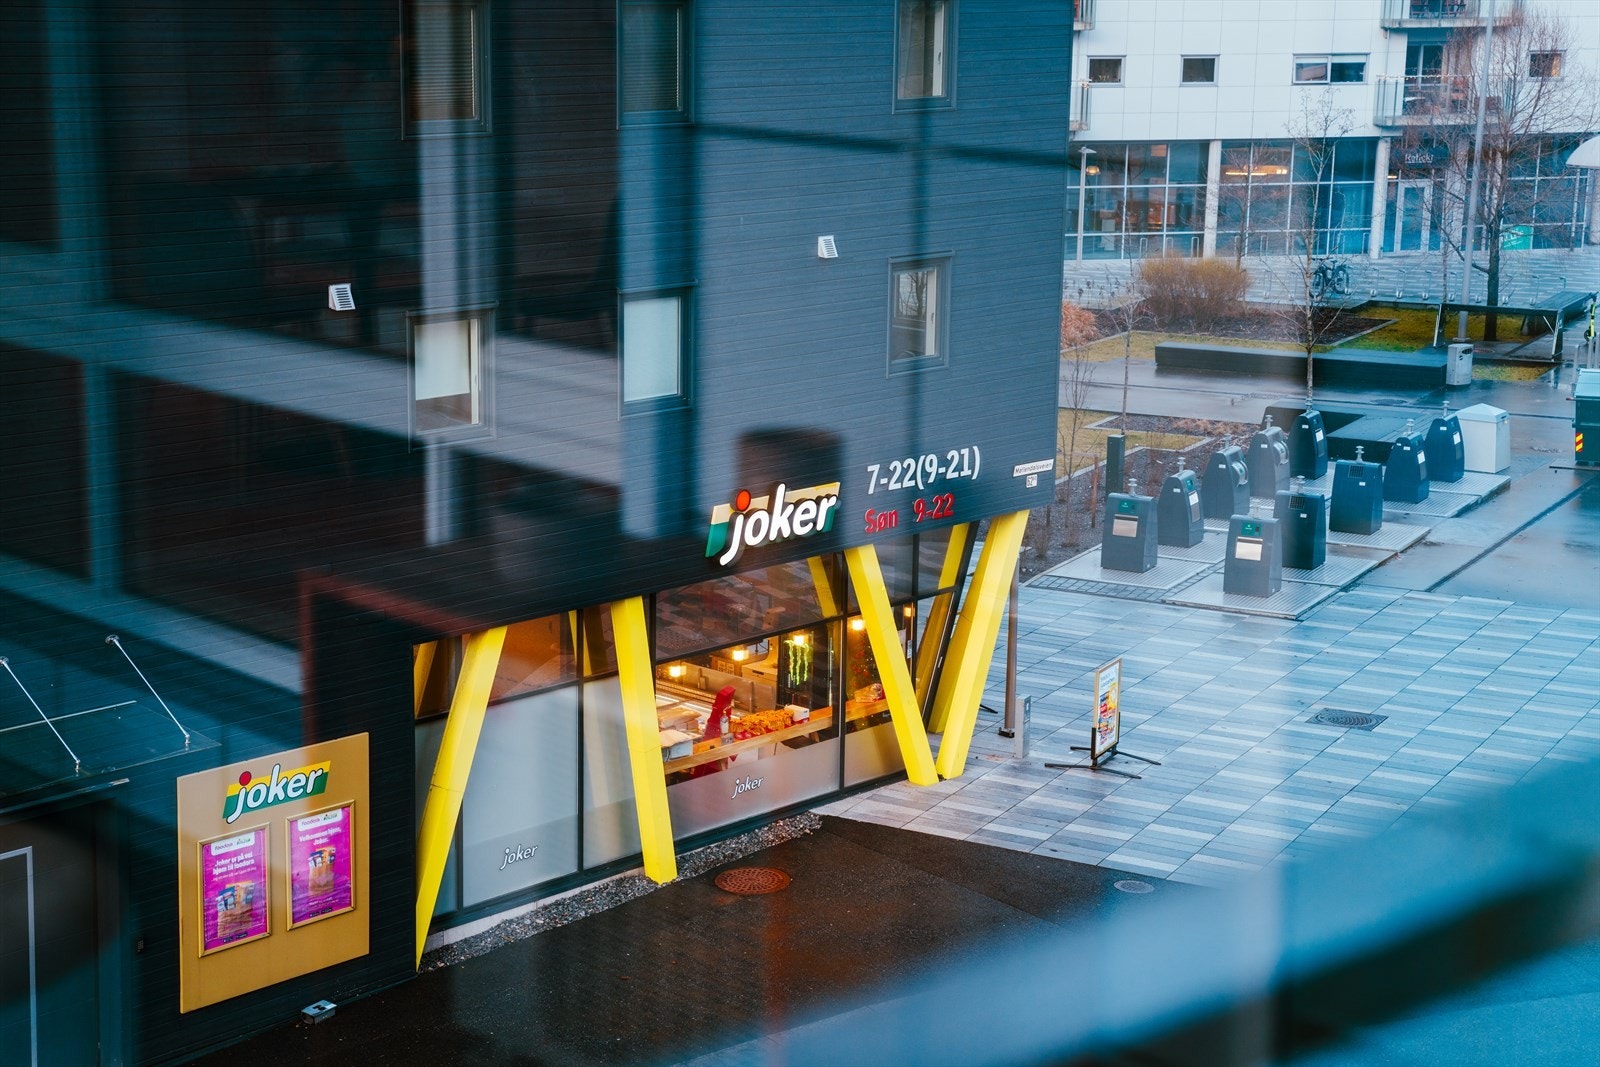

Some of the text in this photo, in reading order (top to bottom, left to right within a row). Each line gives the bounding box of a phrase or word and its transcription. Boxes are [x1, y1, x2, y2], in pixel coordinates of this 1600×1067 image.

[866, 446, 981, 494] 7-22(9-21)
[719, 482, 839, 566] joker
[864, 493, 955, 534] Søn 9-22
[226, 763, 324, 824] joker
[731, 775, 764, 799] joker
[500, 844, 538, 870] joker
